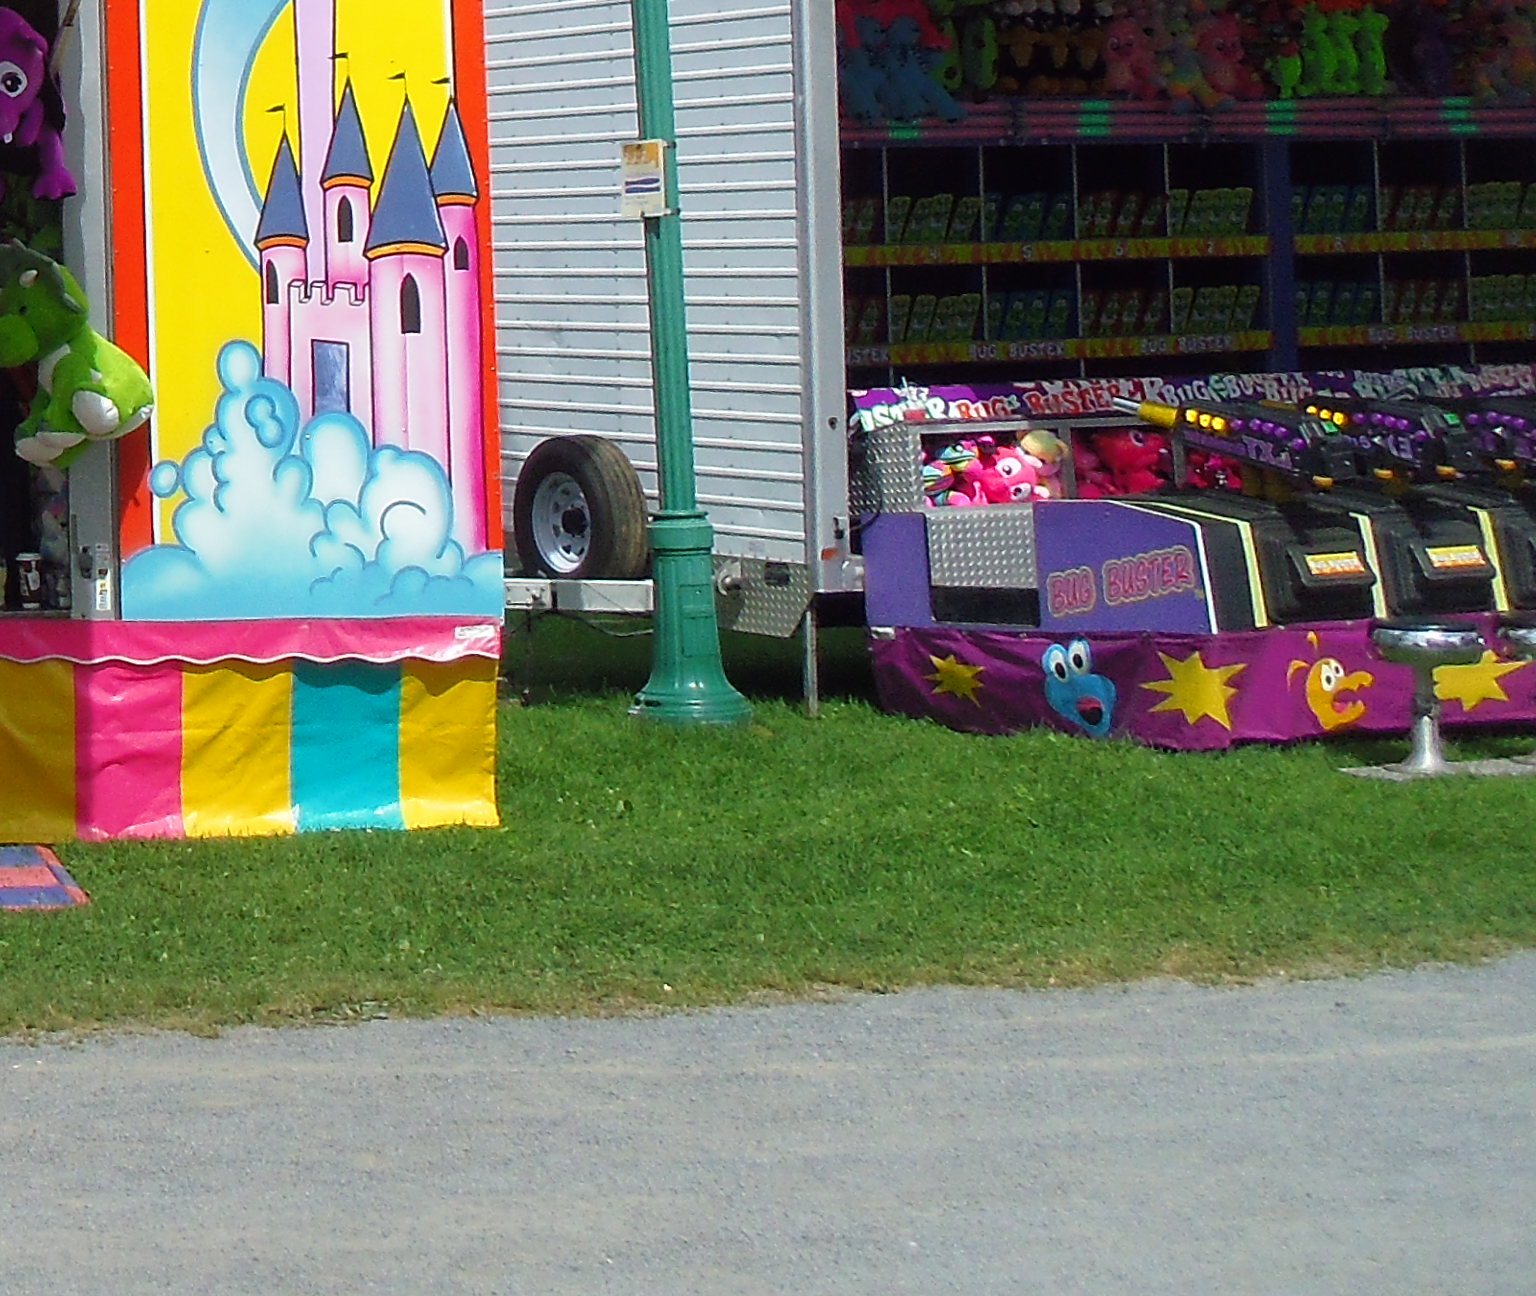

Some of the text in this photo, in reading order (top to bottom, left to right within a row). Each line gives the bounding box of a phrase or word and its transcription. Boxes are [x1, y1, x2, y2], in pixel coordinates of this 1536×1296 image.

[1022, 244, 1034, 258] 5
[1407, 325, 1457, 340] BUSTER
[969, 342, 1064, 358] BUG BUSTER
[1141, 334, 1233, 353] BUG BUSTER
[1024, 382, 1122, 414] BUSTER
[1163, 379, 1210, 406] BUG
[1047, 544, 1195, 618] BUG BUSTER
